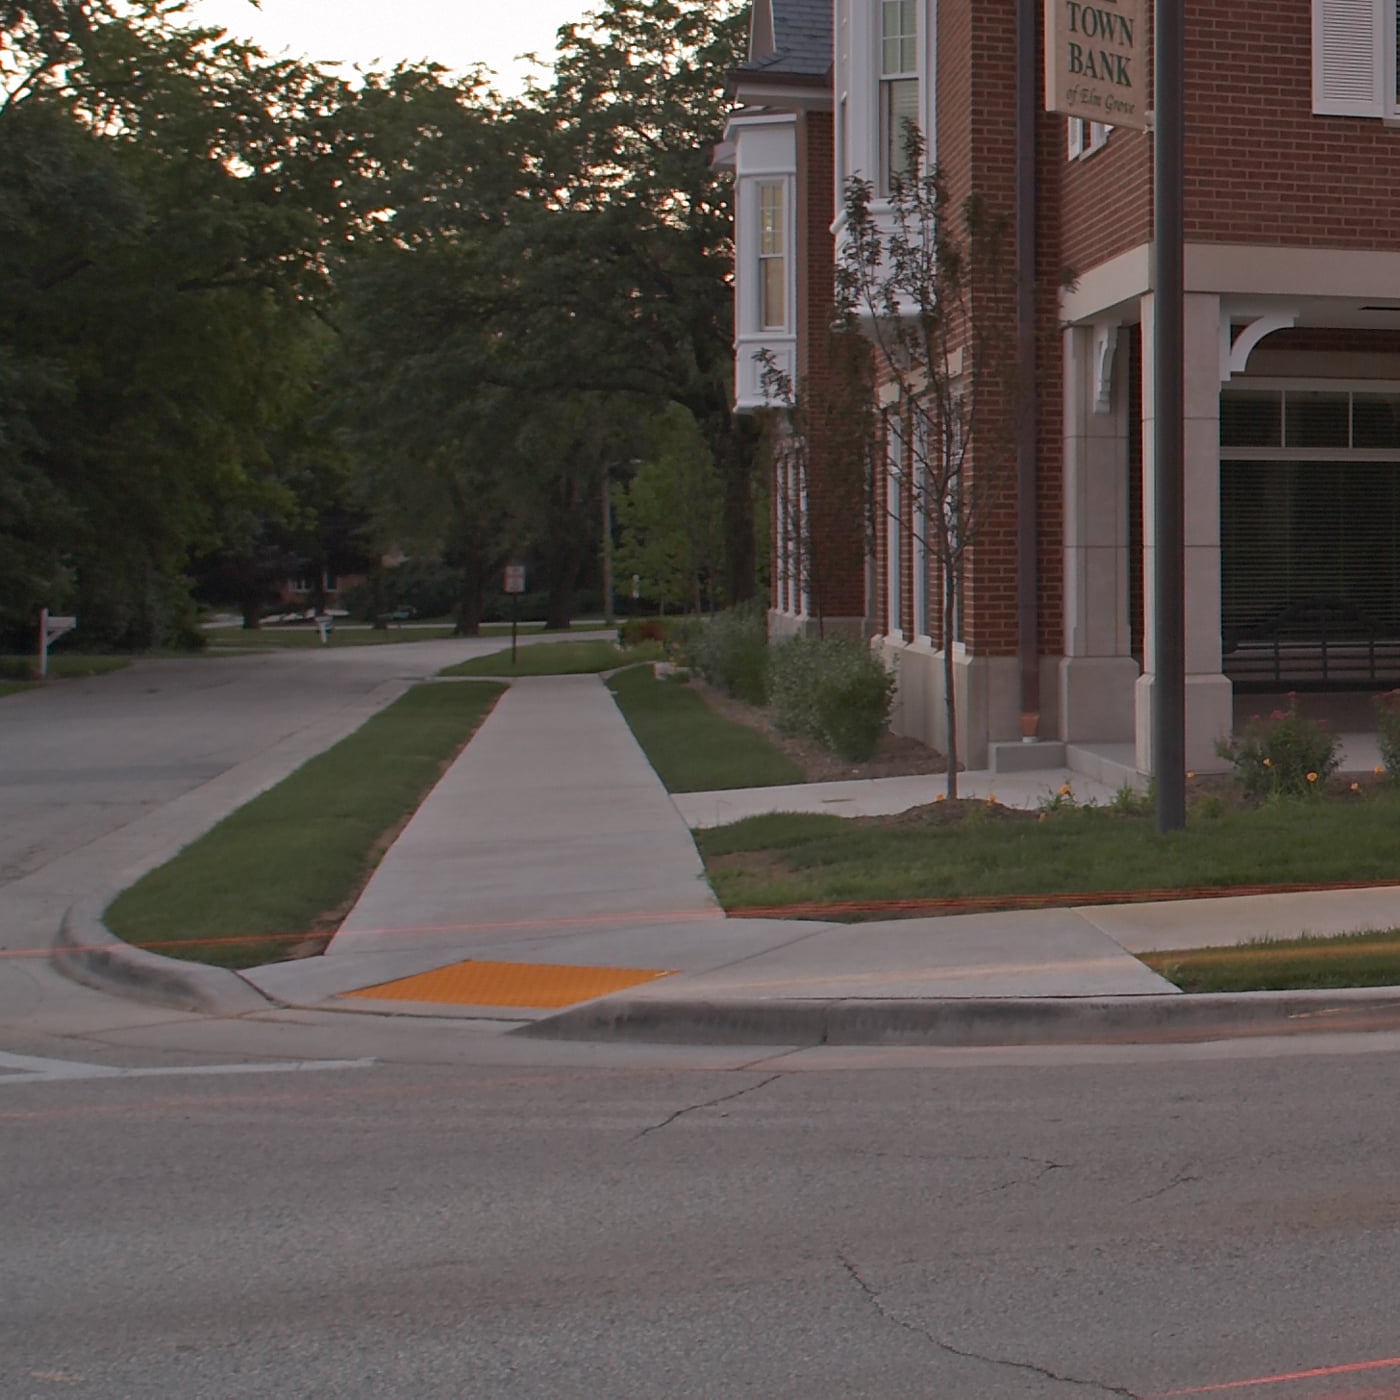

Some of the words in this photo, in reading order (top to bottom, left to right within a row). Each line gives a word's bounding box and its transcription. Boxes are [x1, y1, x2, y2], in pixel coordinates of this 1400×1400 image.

[1066, 0, 1135, 48] TOWN
[1068, 42, 1132, 88] BANK
[1066, 83, 1080, 107] of
[1080, 87, 1102, 107] Elm
[1105, 93, 1136, 115] Grove
